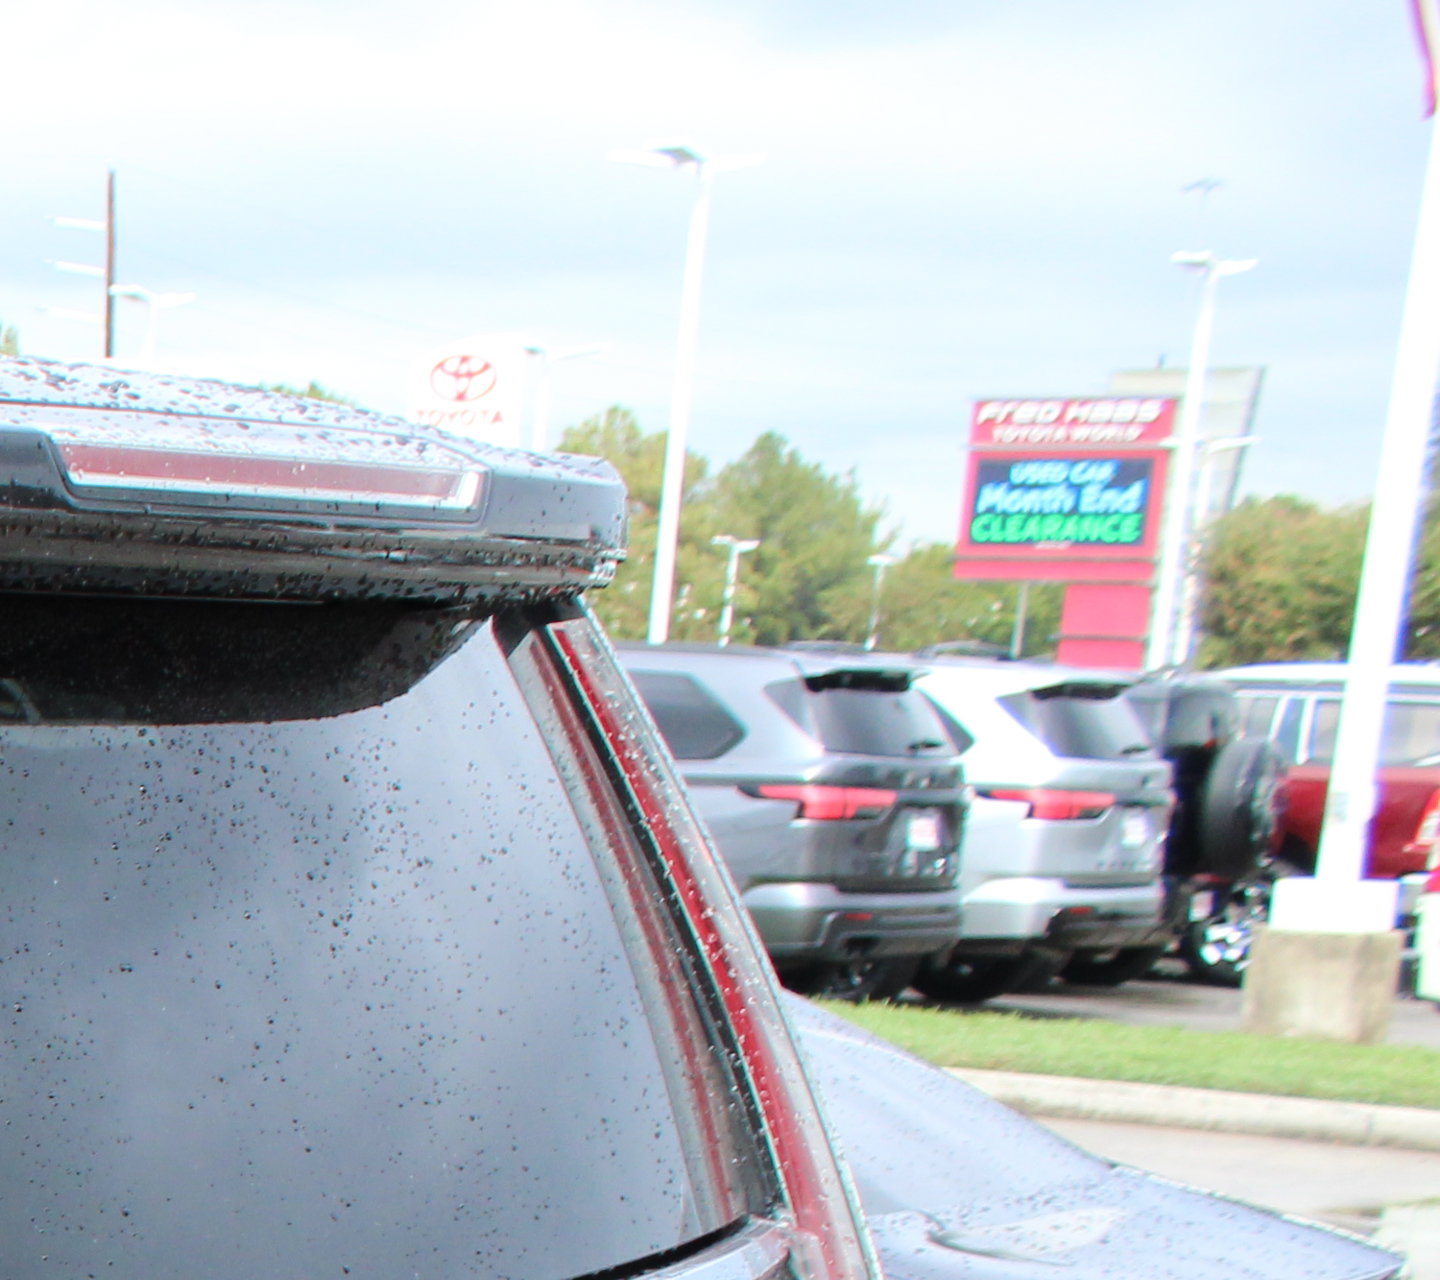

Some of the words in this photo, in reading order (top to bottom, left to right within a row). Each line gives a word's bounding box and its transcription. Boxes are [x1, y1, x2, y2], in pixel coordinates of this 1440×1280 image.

[416, 409, 505, 425] TOYOTA
[992, 424, 1068, 443] TOYOTA
[1069, 424, 1145, 442] WORLD
[1009, 460, 1070, 485] USED
[976, 481, 1077, 514] Month
[1078, 478, 1149, 514] End
[970, 513, 1143, 543] CLEARANCE
